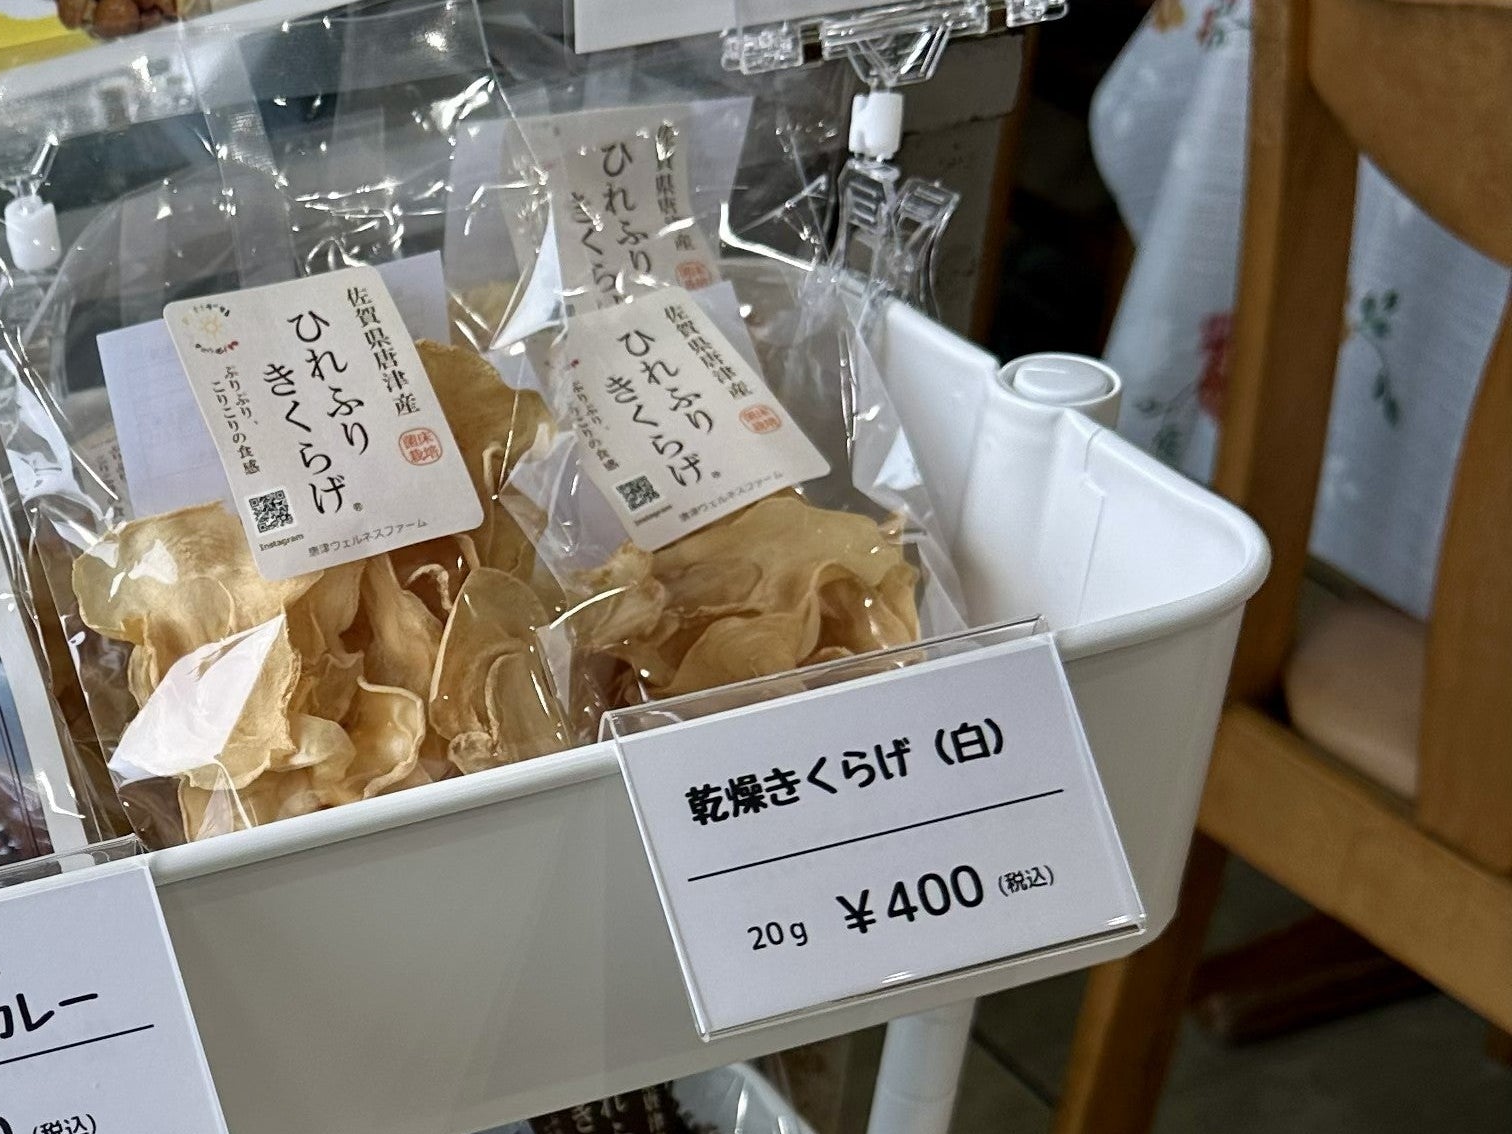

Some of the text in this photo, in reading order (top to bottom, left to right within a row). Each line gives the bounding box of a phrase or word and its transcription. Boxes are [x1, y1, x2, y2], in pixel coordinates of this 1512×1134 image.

[571, 192, 625, 304] きくら
[601, 142, 651, 273] ひれふり
[288, 310, 369, 455] ひれふり
[347, 286, 421, 417] 佐賀県唐津産
[617, 330, 713, 433] ひれふり
[835, 864, 984, 934] ¥400
